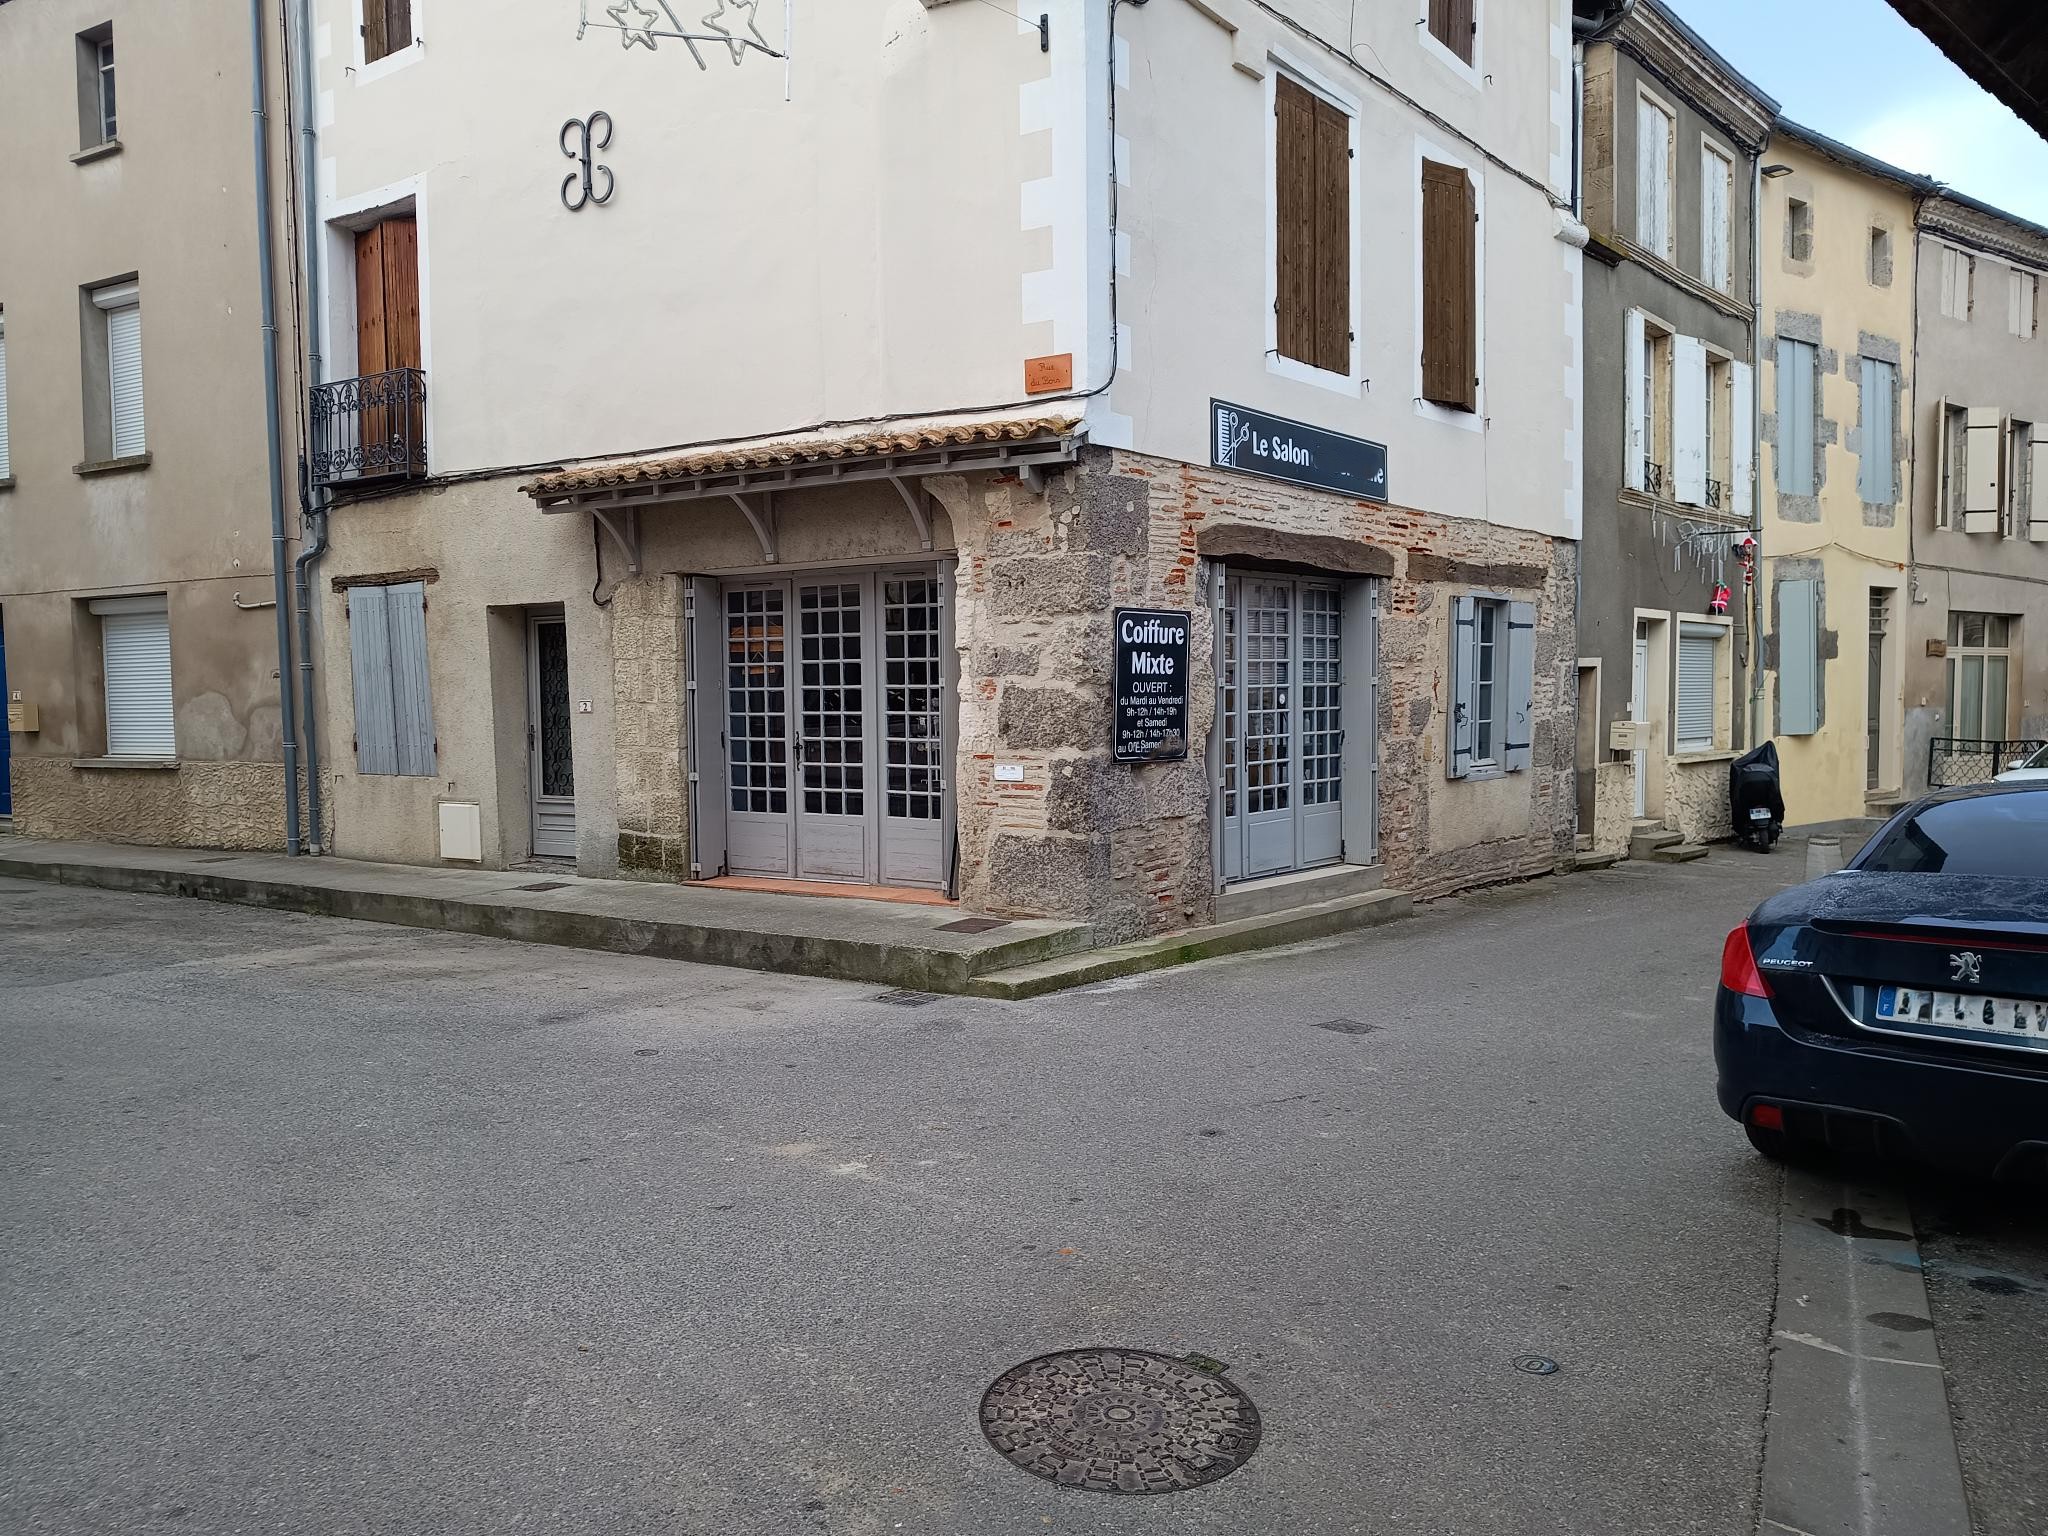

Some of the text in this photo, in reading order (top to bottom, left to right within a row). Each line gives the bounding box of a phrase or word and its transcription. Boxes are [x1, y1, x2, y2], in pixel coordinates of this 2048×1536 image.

[1252, 430, 1309, 466] Le Salon
[1122, 619, 1184, 645] Coiffure
[1132, 651, 1174, 675] Mixte
[1132, 681, 1168, 693] OUVERT
[1120, 695, 1184, 706] du Mardi au Vendredi
[1136, 717, 1168, 728] et Samedi
[1762, 958, 1814, 968] PEUGEOT
[1883, 1003, 1890, 1012] F
